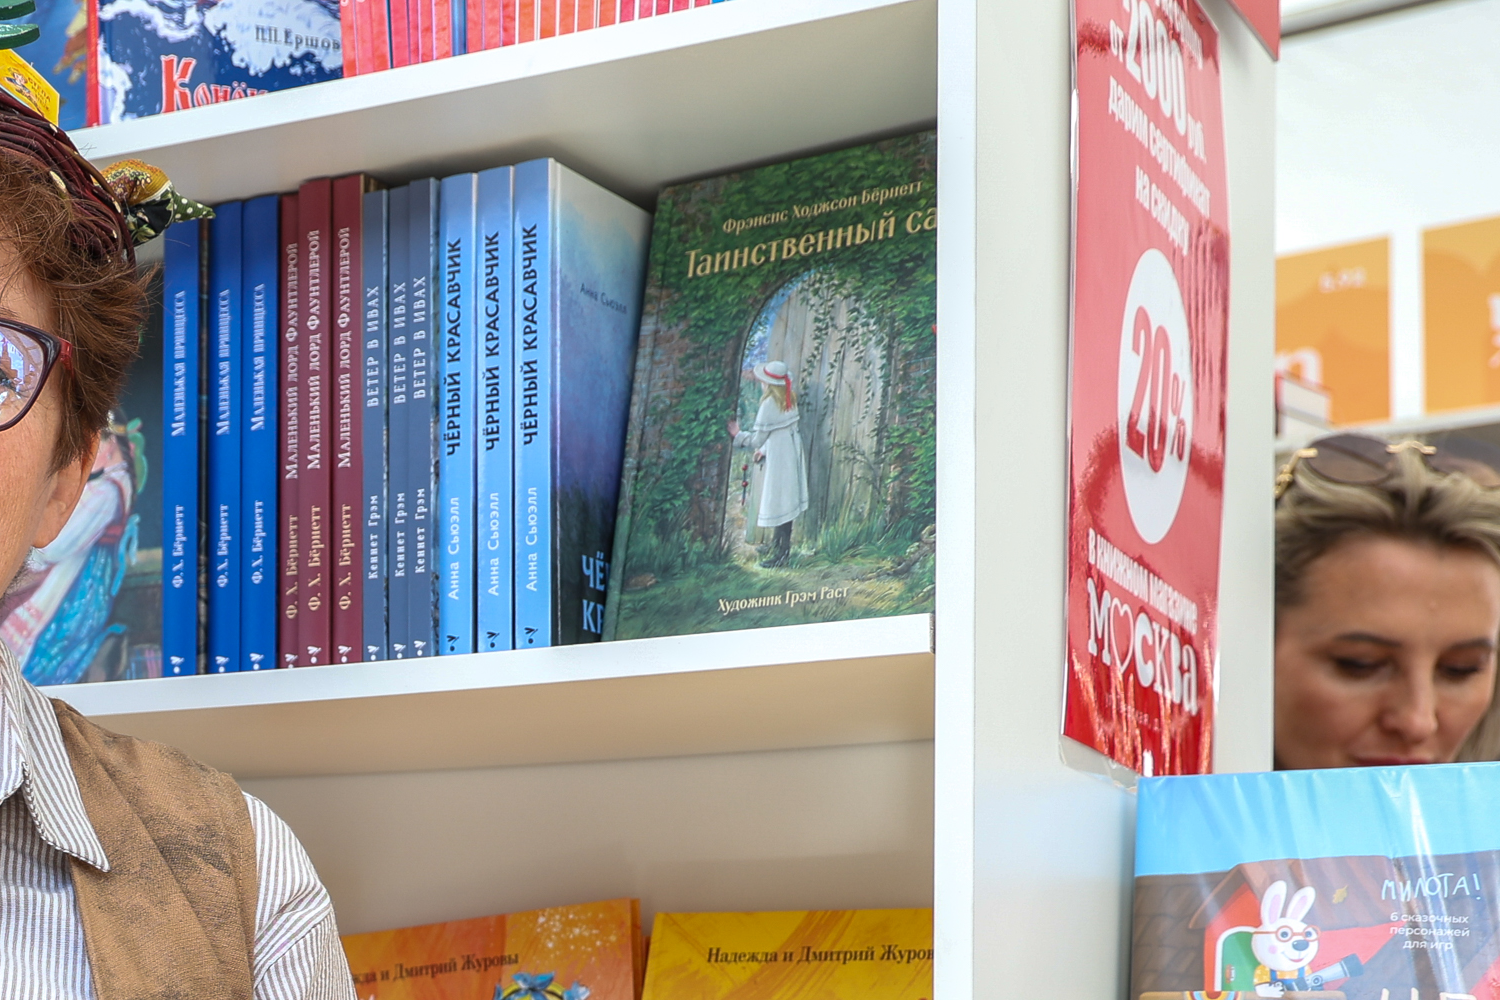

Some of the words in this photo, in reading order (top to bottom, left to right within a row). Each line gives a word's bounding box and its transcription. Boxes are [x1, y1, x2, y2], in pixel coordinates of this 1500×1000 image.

[722, 208, 788, 235] Фрэнсис
[791, 195, 857, 221] Ходжсон
[861, 180, 923, 205] Бёрнетт
[685, 210, 896, 279] Таинственный
[367, 286, 379, 332] ИВАХ
[394, 282, 406, 329] ИВАХ
[414, 276, 426, 323] ИВАХ
[447, 238, 461, 363] КРАСАВЧИК
[485, 231, 500, 358] КРАСАВЧИК
[522, 224, 538, 351] КРАСАВЧИК
[367, 338, 379, 348] В
[394, 335, 406, 345] В
[414, 330, 426, 340] В
[367, 356, 379, 408] ВЕТЕР
[394, 353, 406, 404] ВЕТЕР
[414, 347, 426, 399] ВЕТЕР
[1126, 305, 1186, 474] 20%
[443, 371, 461, 456] ЧЁРНЫЙ
[482, 366, 500, 451] ЧЁРНЫЙ
[520, 359, 538, 445] ЧЁРНЫЙ
[251, 500, 267, 553] Бёрнетт
[368, 495, 380, 527] Грэм
[395, 492, 407, 524] Грэм
[415, 488, 428, 520] Грэм
[448, 497, 460, 554] Сьюэлл
[488, 492, 500, 551] Сьюэлл
[526, 487, 538, 546] Сьюэлл
[172, 505, 187, 557] Бёрнетт
[217, 504, 232, 556] Бёрнетт
[285, 515, 299, 576] Бёрнетт
[308, 505, 325, 568] Бёрнетт
[338, 504, 355, 566] Бёрнетт
[415, 526, 426, 574] Кеннет
[368, 533, 378, 580] Кеннет
[395, 531, 405, 578] Кеннет
[488, 557, 500, 597] Анна
[526, 552, 538, 592] Анна
[448, 562, 460, 600] Анна
[717, 594, 782, 616] Художник
[785, 590, 817, 607] Грэм
[820, 586, 850, 600] Раст
[1381, 873, 1481, 902] МИЛОТА!
[1389, 926, 1470, 937] персонажей
[1401, 914, 1469, 923] сказочных
[393, 958, 457, 982] Дмитрий
[461, 953, 519, 974] Журовы
[707, 947, 778, 964] Надежда
[783, 951, 794, 962] и
[797, 946, 875, 965] Дмитрий
[1402, 941, 1427, 949] для
[1430, 941, 1454, 951] игр
